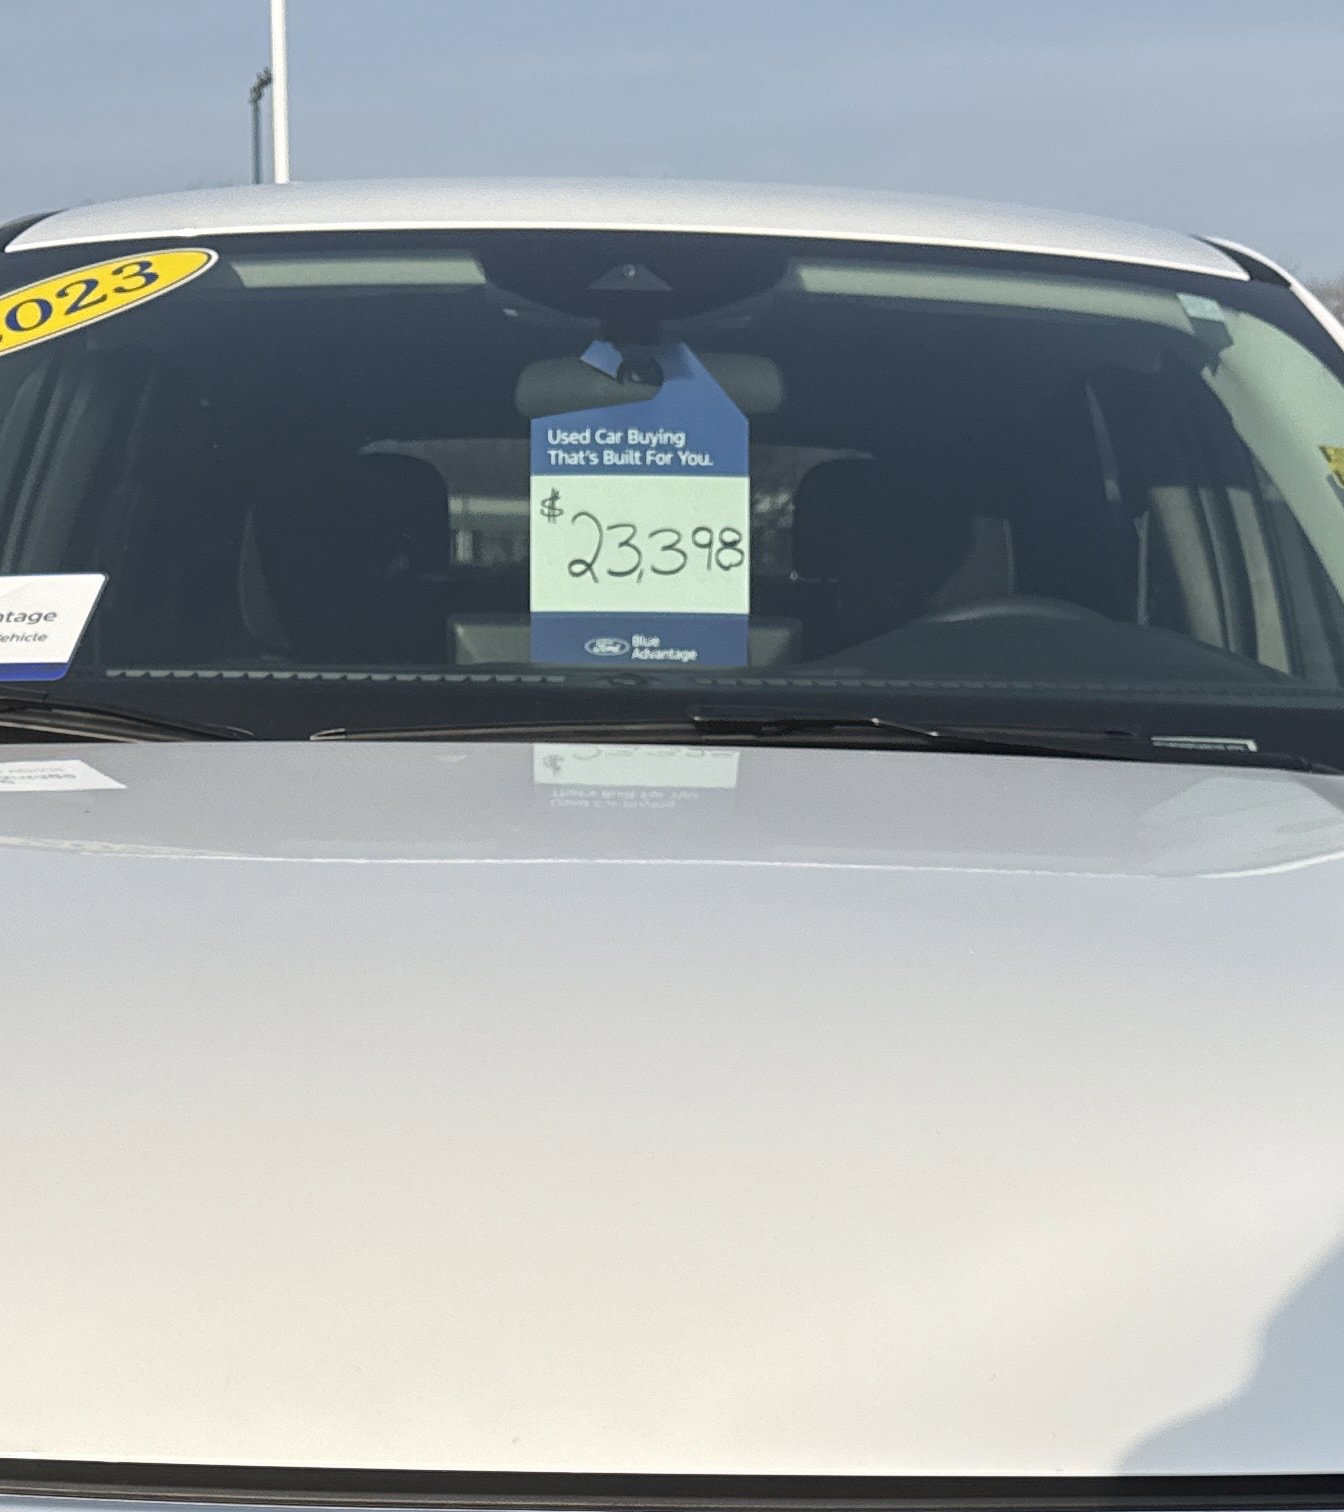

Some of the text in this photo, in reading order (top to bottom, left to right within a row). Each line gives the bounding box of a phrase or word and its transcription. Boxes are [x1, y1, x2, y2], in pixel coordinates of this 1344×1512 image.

[547, 429, 686, 448] Used Car Buying
[547, 449, 714, 467] That's Built For You.
[632, 634, 661, 647] Blue
[632, 648, 698, 662] Advantage
